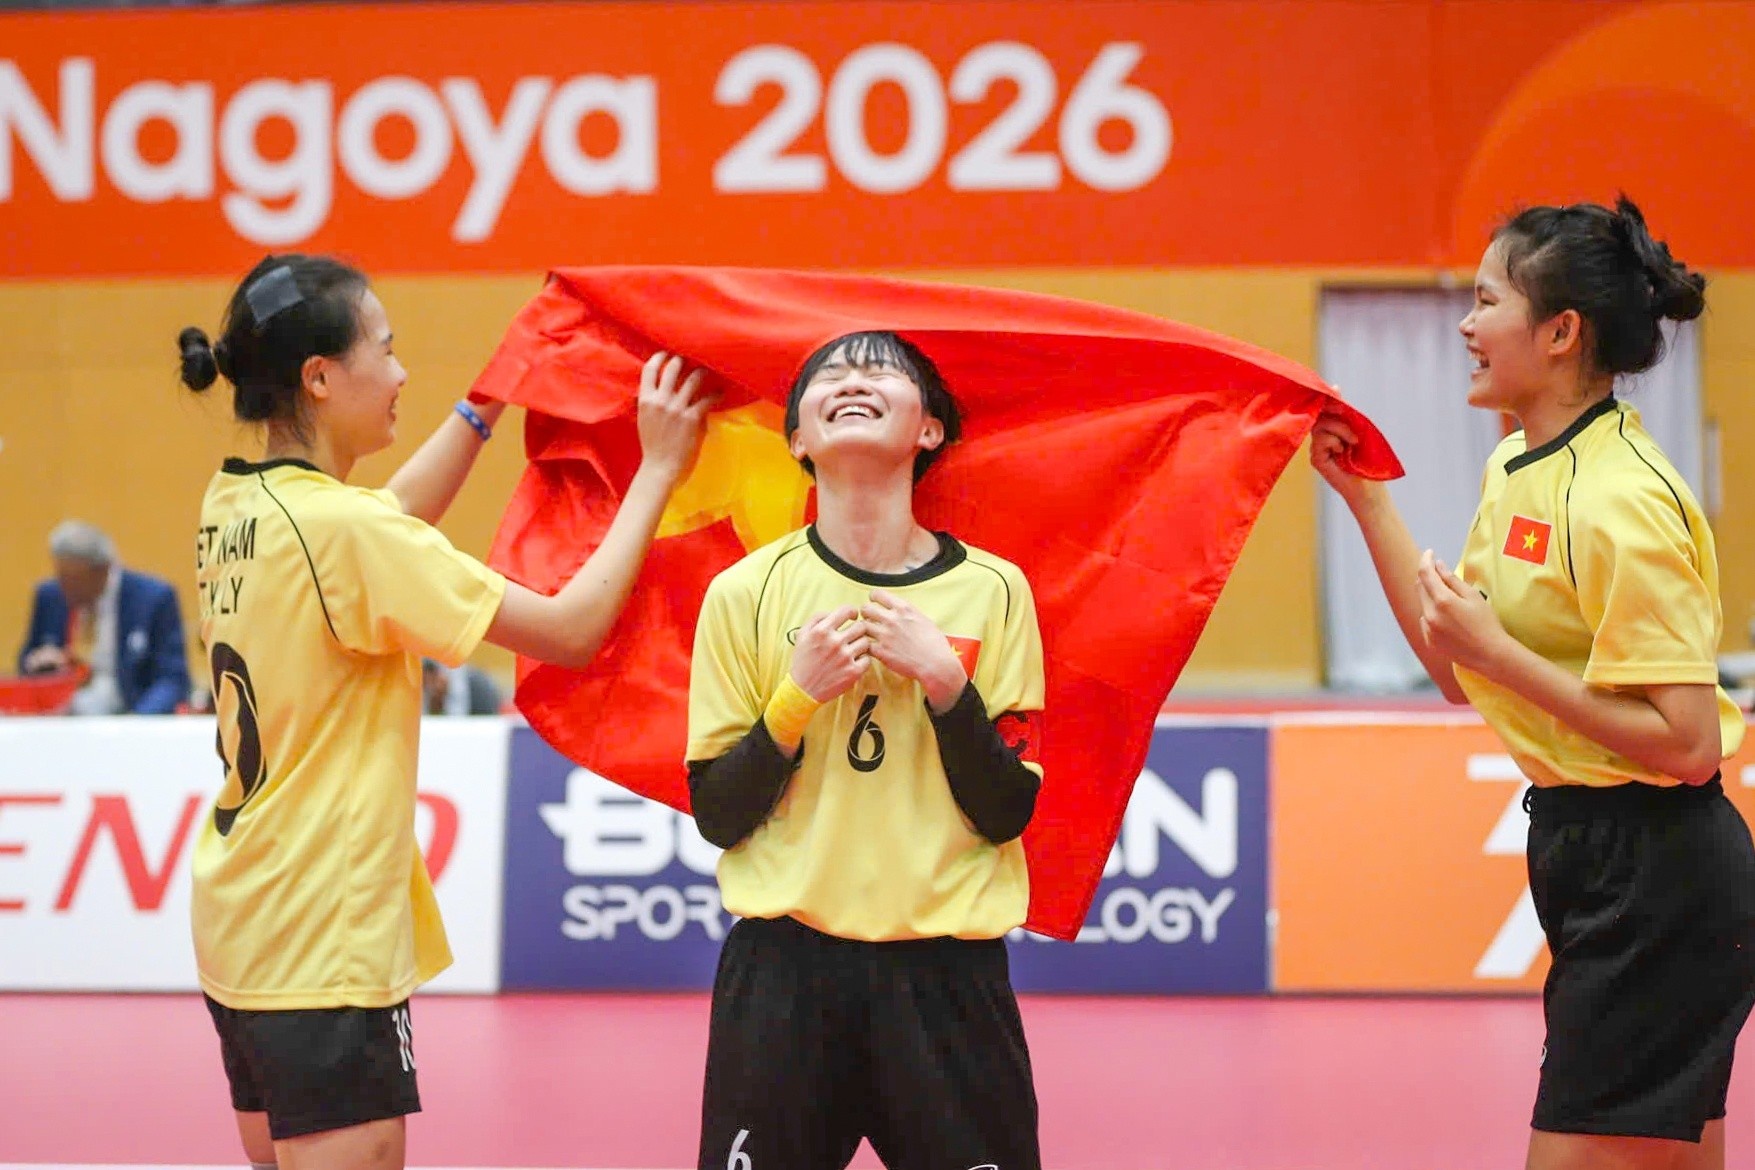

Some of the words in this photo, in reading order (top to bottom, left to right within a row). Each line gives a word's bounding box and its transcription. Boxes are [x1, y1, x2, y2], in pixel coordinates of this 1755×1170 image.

[0, 57, 656, 244] Nagoya
[713, 41, 1173, 193] 2026
[217, 518, 256, 564] NAM
[847, 694, 886, 773] 6
[560, 884, 742, 941] SPOR
